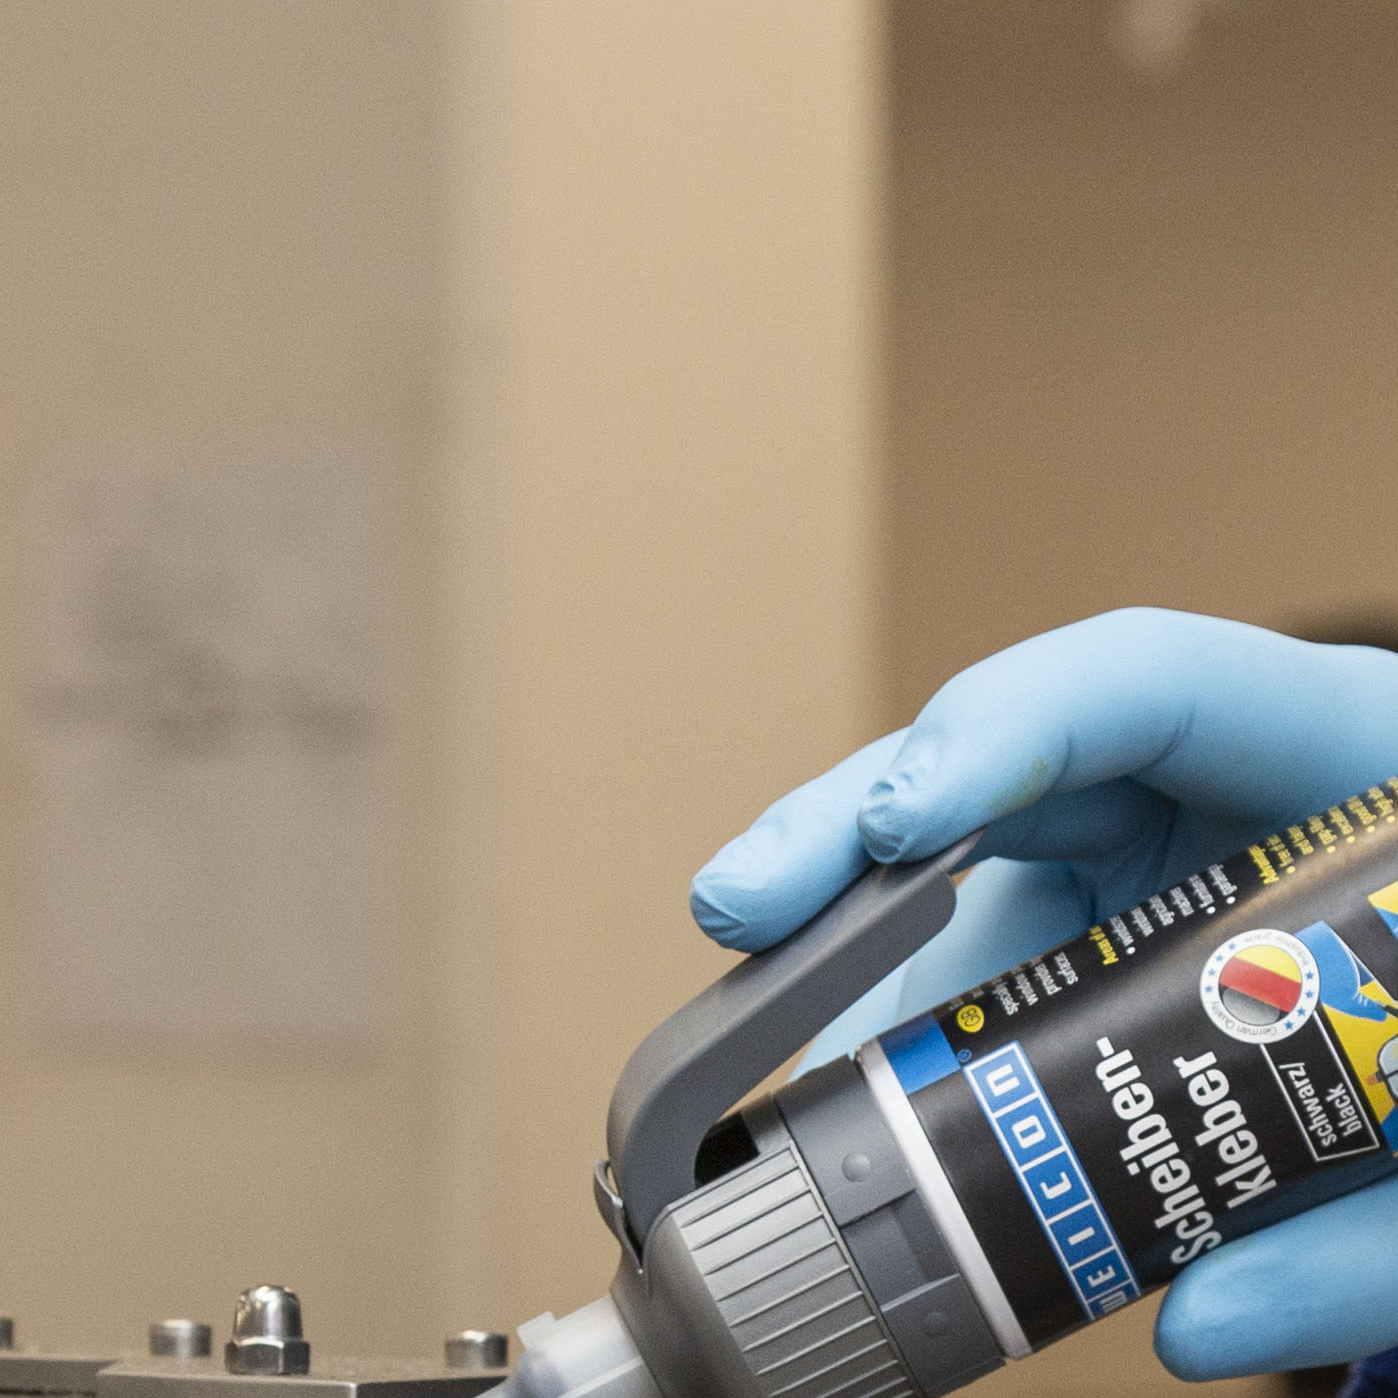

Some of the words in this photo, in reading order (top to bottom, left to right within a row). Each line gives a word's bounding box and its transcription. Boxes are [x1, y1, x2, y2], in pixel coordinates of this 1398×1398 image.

[1095, 940, 1118, 965] Areas
[1171, 1049, 1277, 1209] kleber
[1278, 1062, 1338, 1147] schwarz/
[1326, 1081, 1363, 1136] black
[1093, 1035, 1222, 1269] Scheiben-
